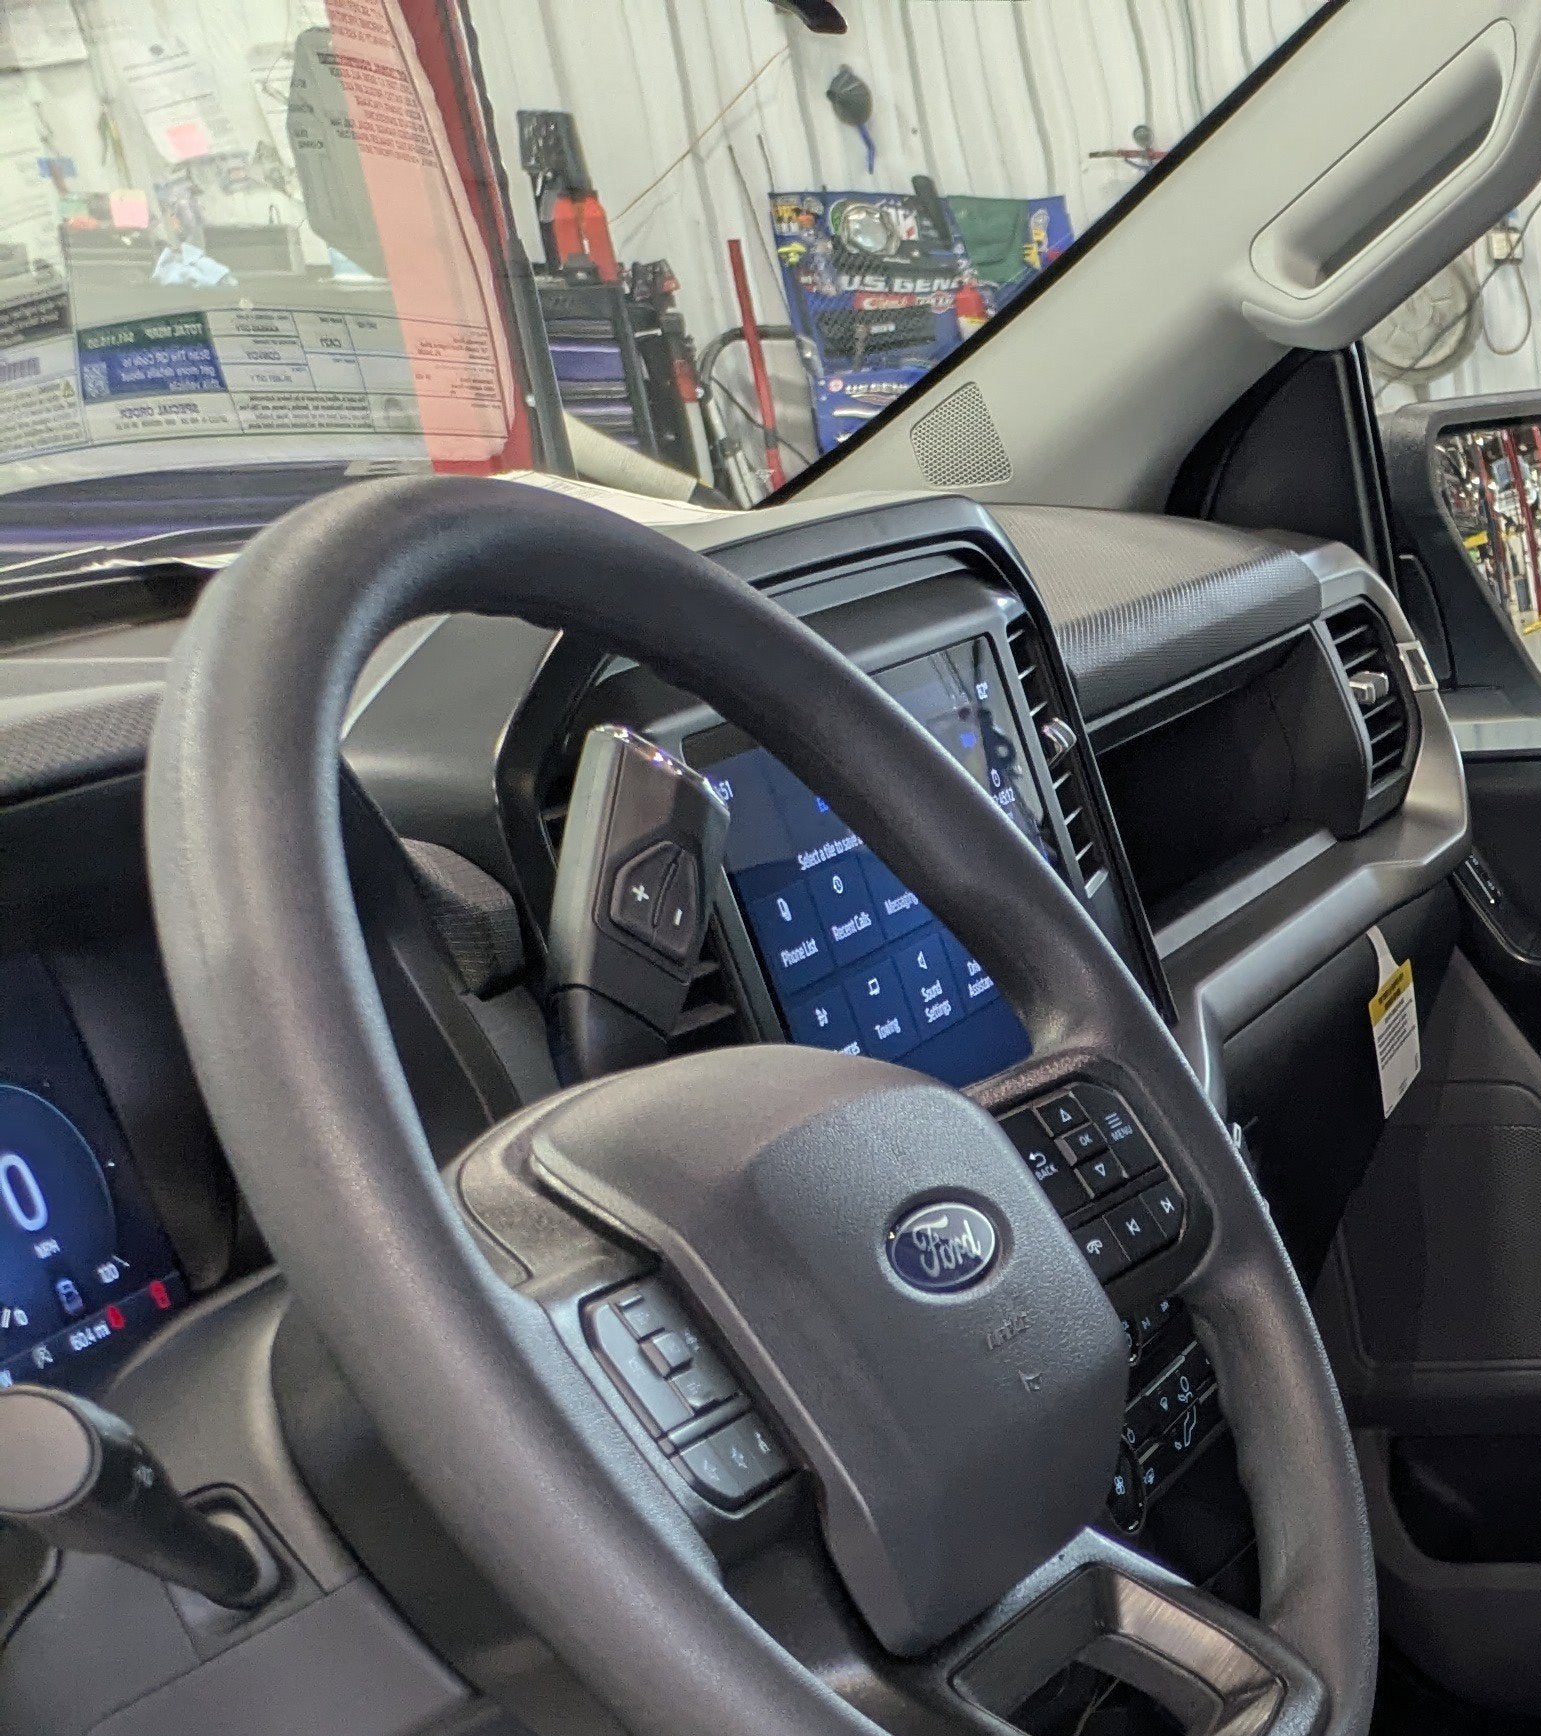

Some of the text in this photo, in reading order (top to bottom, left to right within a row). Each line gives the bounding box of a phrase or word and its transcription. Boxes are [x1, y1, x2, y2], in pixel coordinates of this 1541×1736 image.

[831, 911, 872, 942] Recent Calls
[780, 938, 819, 968] Phone List
[921, 979, 943, 1002] Sound
[925, 999, 951, 1023] Settings
[875, 1017, 901, 1040] Towing
[1078, 1134, 1093, 1147] OK
[1110, 1125, 1134, 1141] MENU
[1034, 1164, 1058, 1181] BACK
[912, 1214, 981, 1278] Ford
